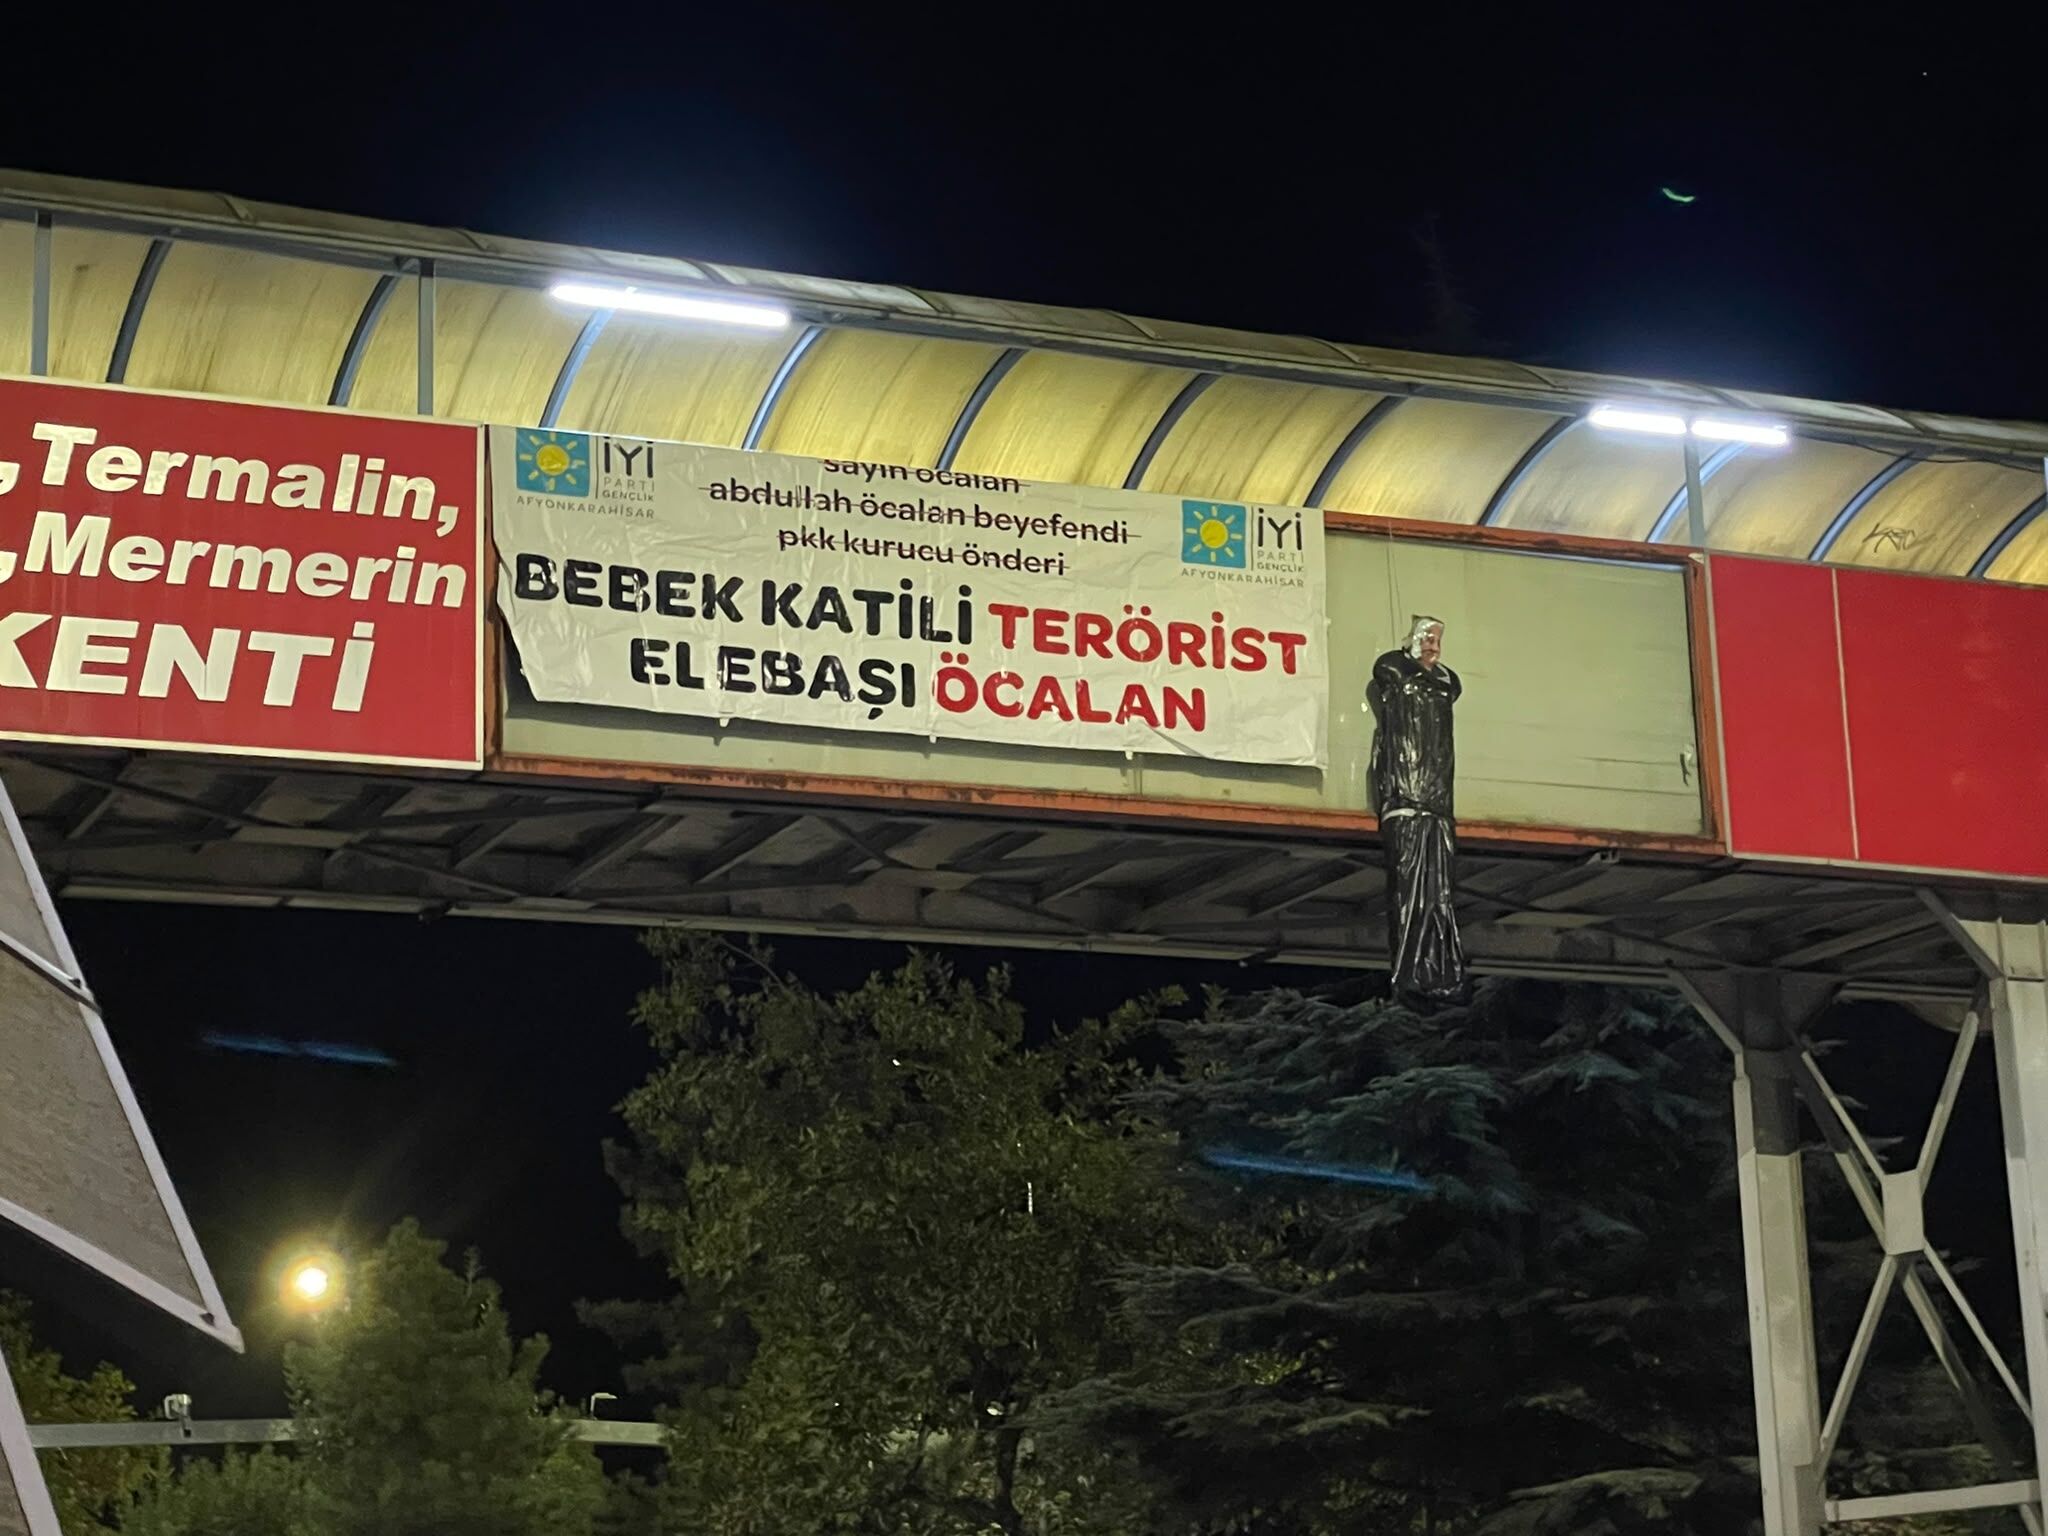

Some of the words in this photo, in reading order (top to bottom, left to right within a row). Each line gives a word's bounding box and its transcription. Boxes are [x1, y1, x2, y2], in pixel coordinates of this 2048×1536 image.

[32, 422, 459, 537] Termalin,
[603, 436, 654, 479] İYİ
[516, 495, 655, 519] AFYONKARAHİSAR
[709, 477, 852, 514] abdullah
[860, 492, 966, 527] öcalan
[974, 503, 1128, 544] beyefendi
[1258, 507, 1302, 551] İYİ
[23, 510, 467, 608] Mermerin
[778, 525, 836, 551] pkk
[844, 529, 954, 564] kurucu
[962, 543, 1065, 576] önderi
[1181, 567, 1304, 588] AFYONKARAHİSAR
[514, 552, 744, 623] BEBEK
[761, 577, 973, 645] KATİLİ
[987, 602, 1307, 675] TERÖRİST
[630, 637, 916, 720] ELEBAŞI
[932, 651, 1206, 732] ÖCALAN
